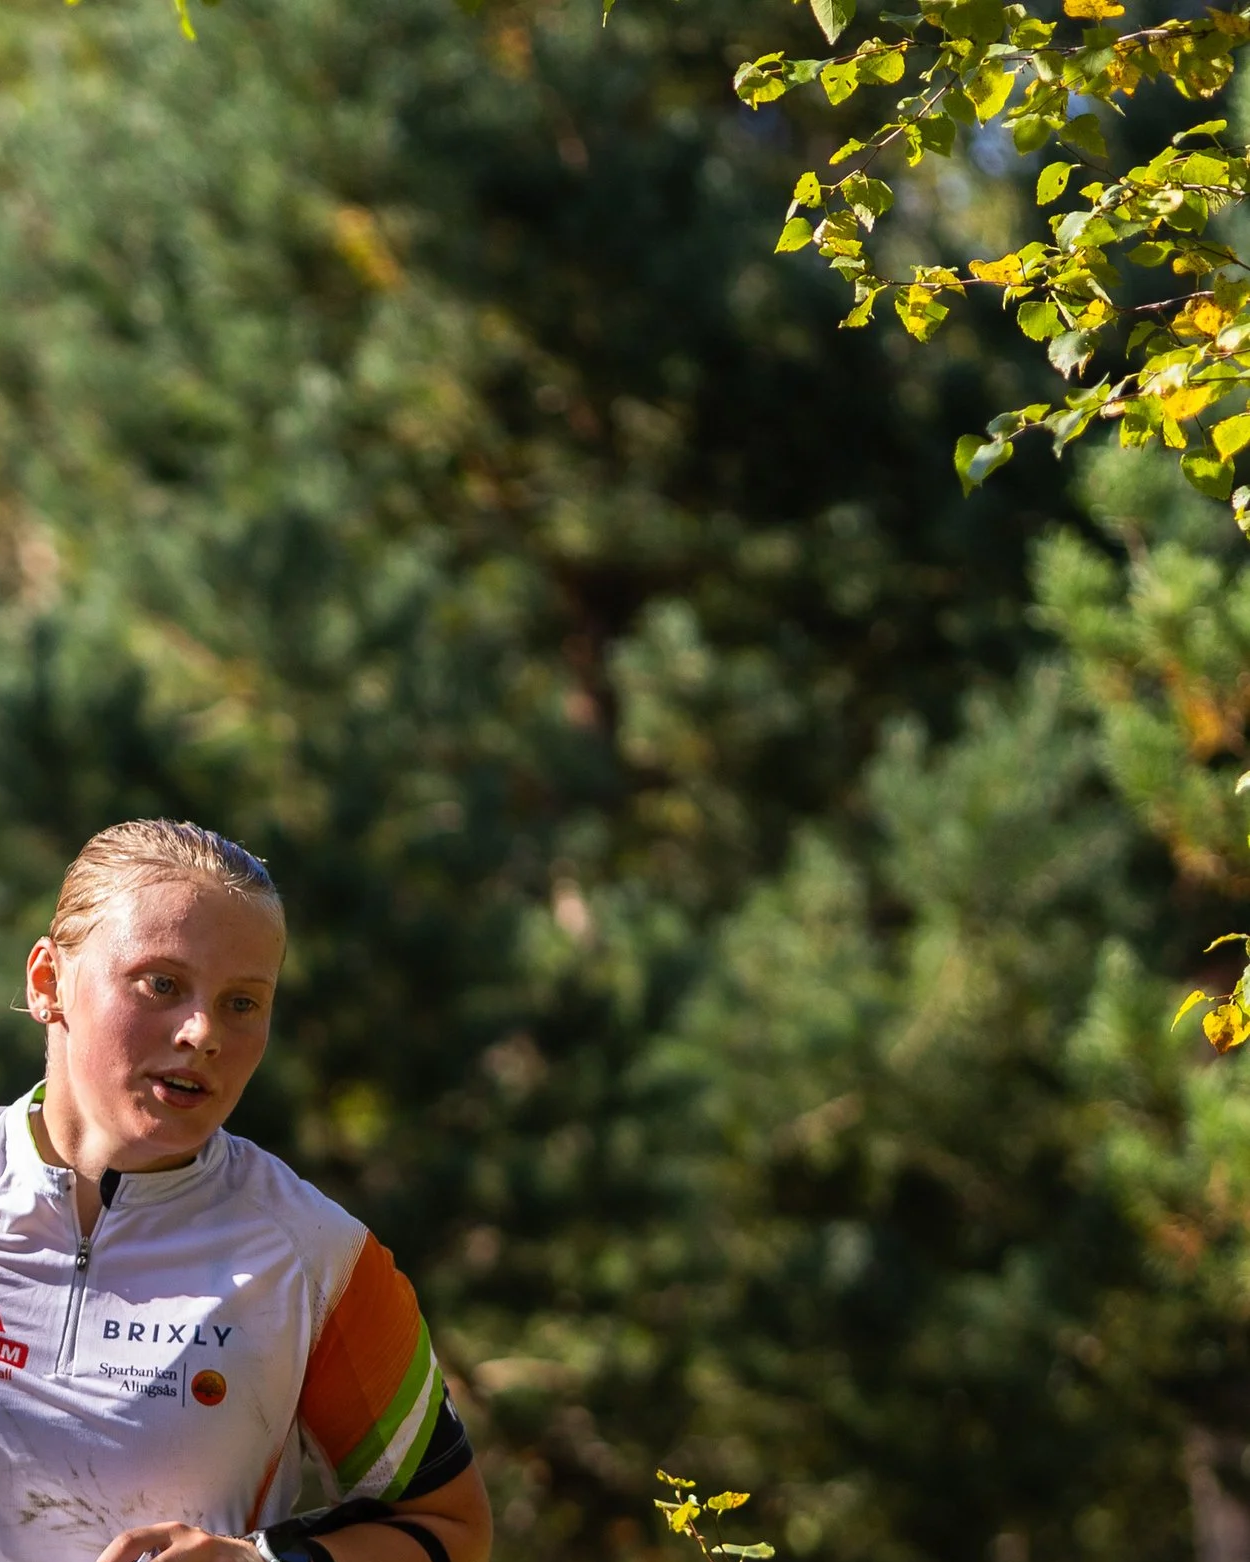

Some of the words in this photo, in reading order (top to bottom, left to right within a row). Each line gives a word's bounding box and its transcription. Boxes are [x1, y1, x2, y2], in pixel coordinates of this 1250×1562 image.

[103, 1319, 232, 1347] BRIXLY
[99, 1362, 177, 1380] Sparbanken
[119, 1379, 177, 1398] Alingsås
